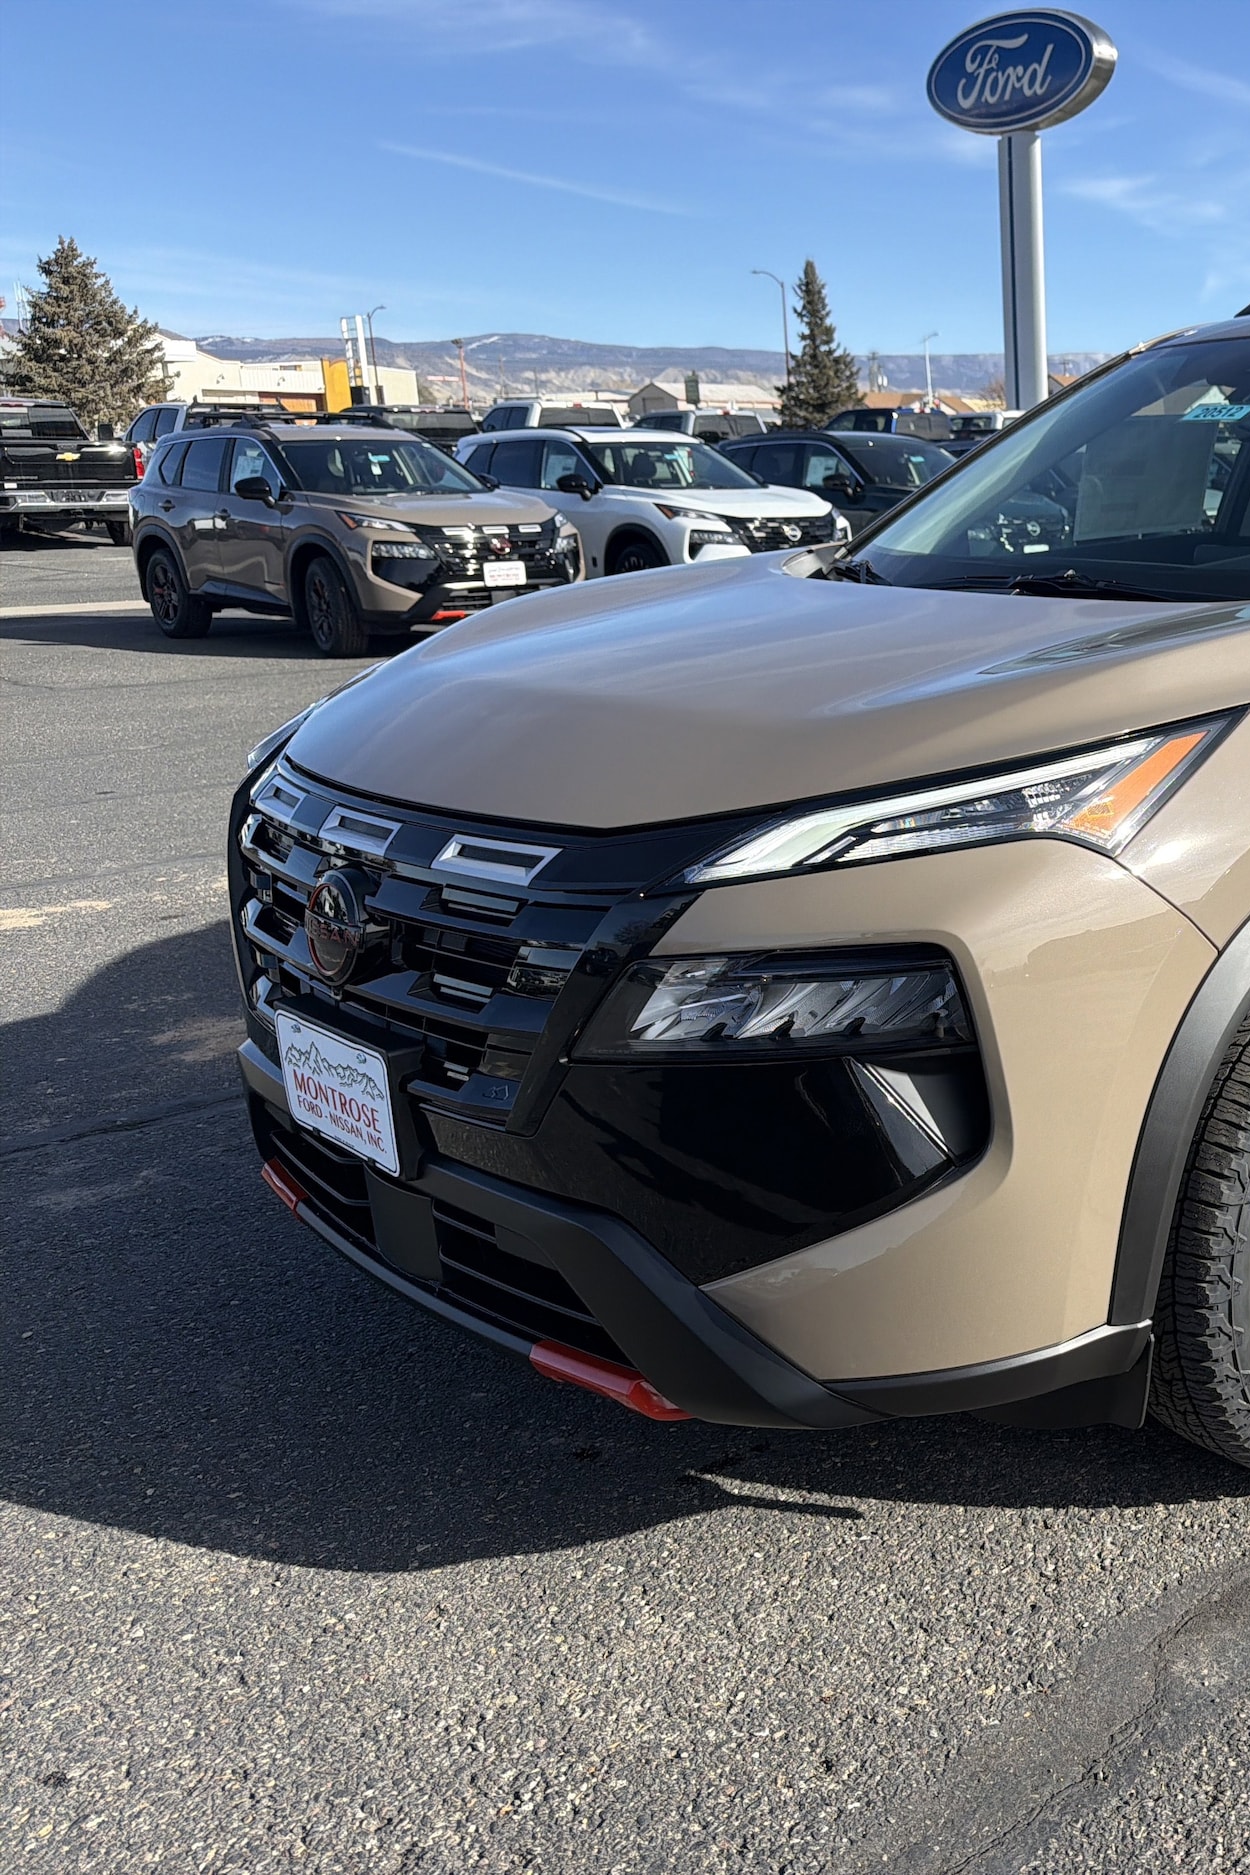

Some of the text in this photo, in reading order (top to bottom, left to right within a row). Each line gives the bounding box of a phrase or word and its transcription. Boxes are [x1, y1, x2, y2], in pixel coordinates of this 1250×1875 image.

[957, 33, 1055, 109] Ford
[1194, 406, 1244, 419] 20512
[293, 1069, 382, 1134] MONTROSE
[297, 1095, 323, 1119] FORD
[329, 1114, 366, 1145] NISSAN,
[367, 1128, 388, 1154] INC.
